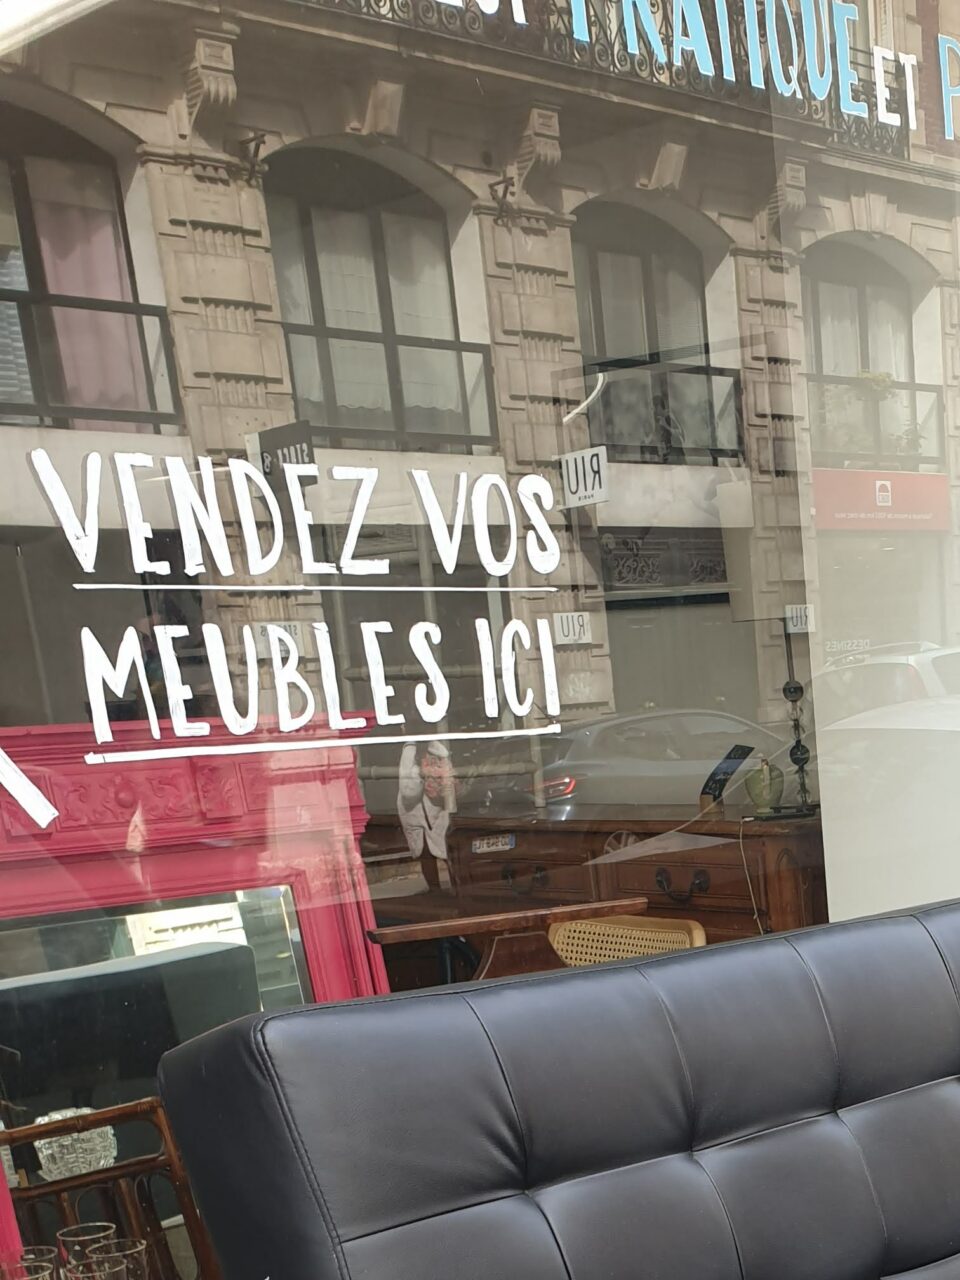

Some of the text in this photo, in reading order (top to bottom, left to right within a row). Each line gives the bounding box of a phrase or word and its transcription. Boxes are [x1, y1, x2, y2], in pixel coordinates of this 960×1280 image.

[872, 45, 918, 131] ET
[31, 448, 562, 577] VENDEZ VOS
[81, 618, 561, 745] MEUBLES ICI
